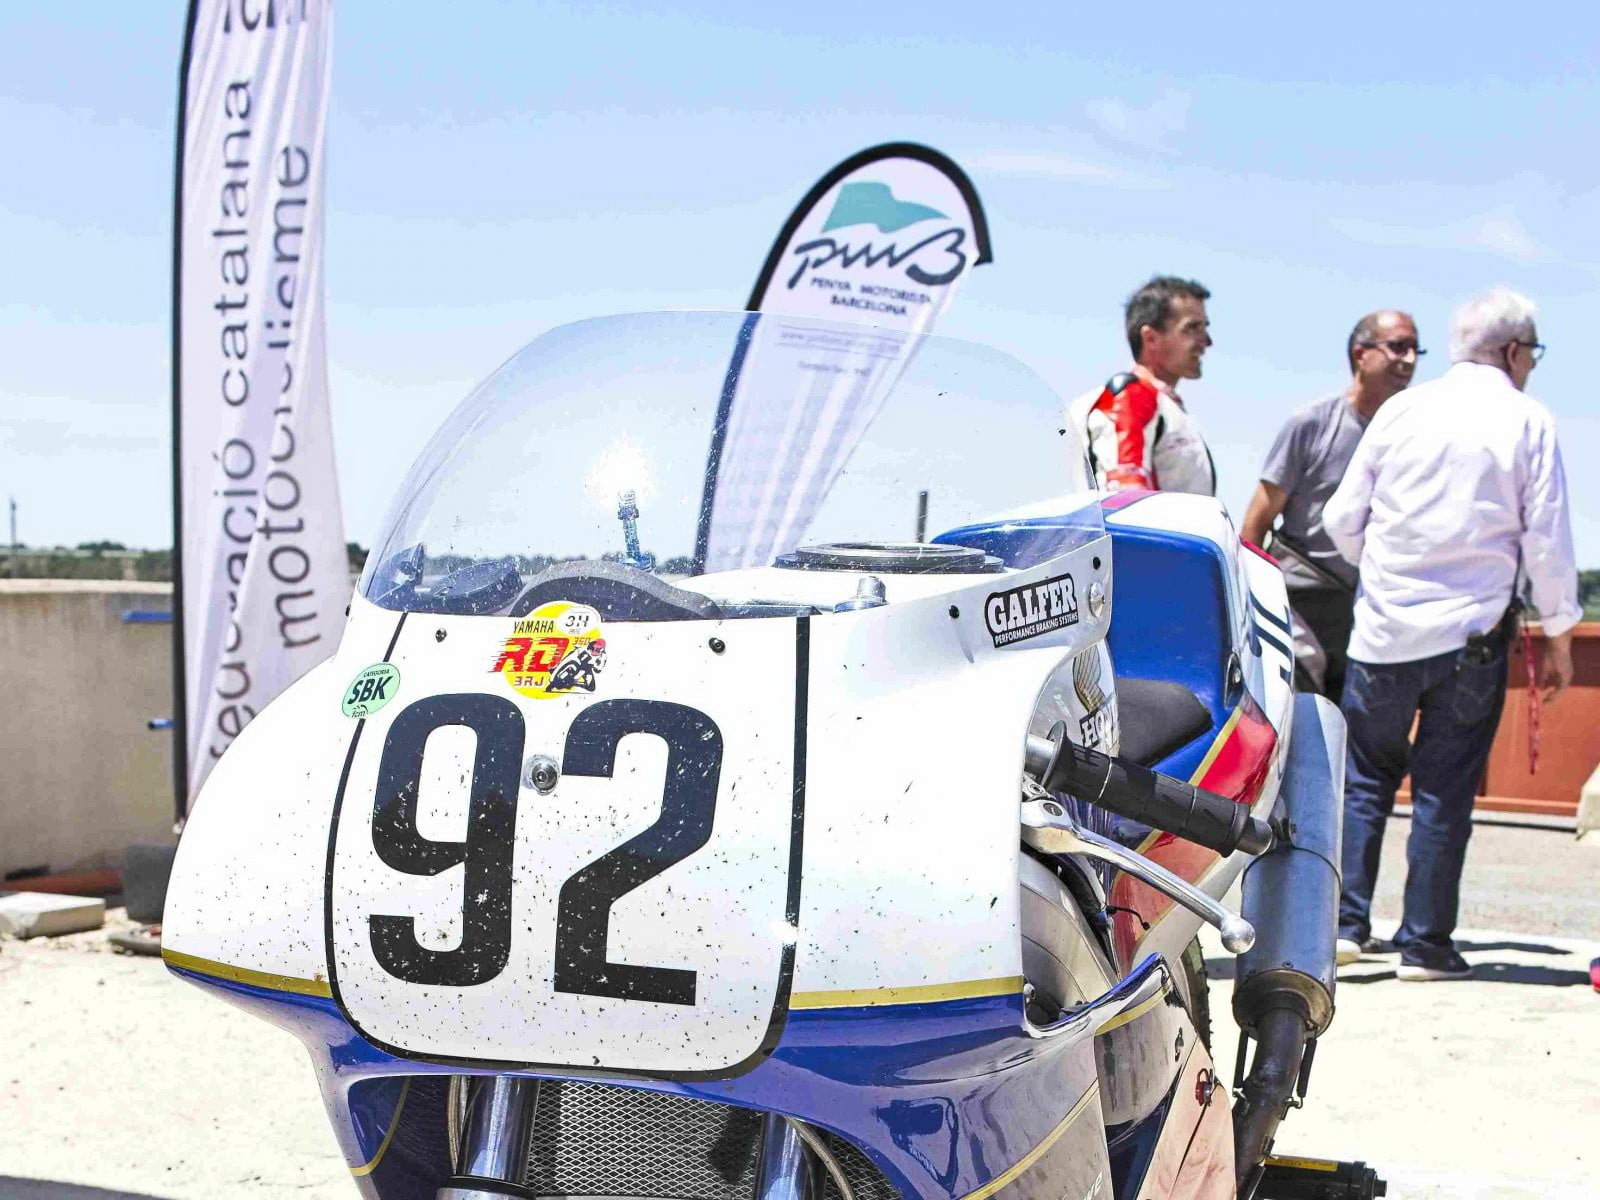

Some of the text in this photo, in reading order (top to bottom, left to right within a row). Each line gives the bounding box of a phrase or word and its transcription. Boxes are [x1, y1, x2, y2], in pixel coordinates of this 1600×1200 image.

[211, 79, 252, 406] catalana
[830, 295, 907, 316] BARCELONA
[988, 577, 1078, 634] GALFER
[514, 620, 555, 634] YAMAHA
[994, 612, 1078, 646] PERFORMANCE BRAKING SYSTEMS
[491, 637, 570, 673] RD
[347, 675, 394, 705] SBK
[370, 692, 724, 1007] 92
